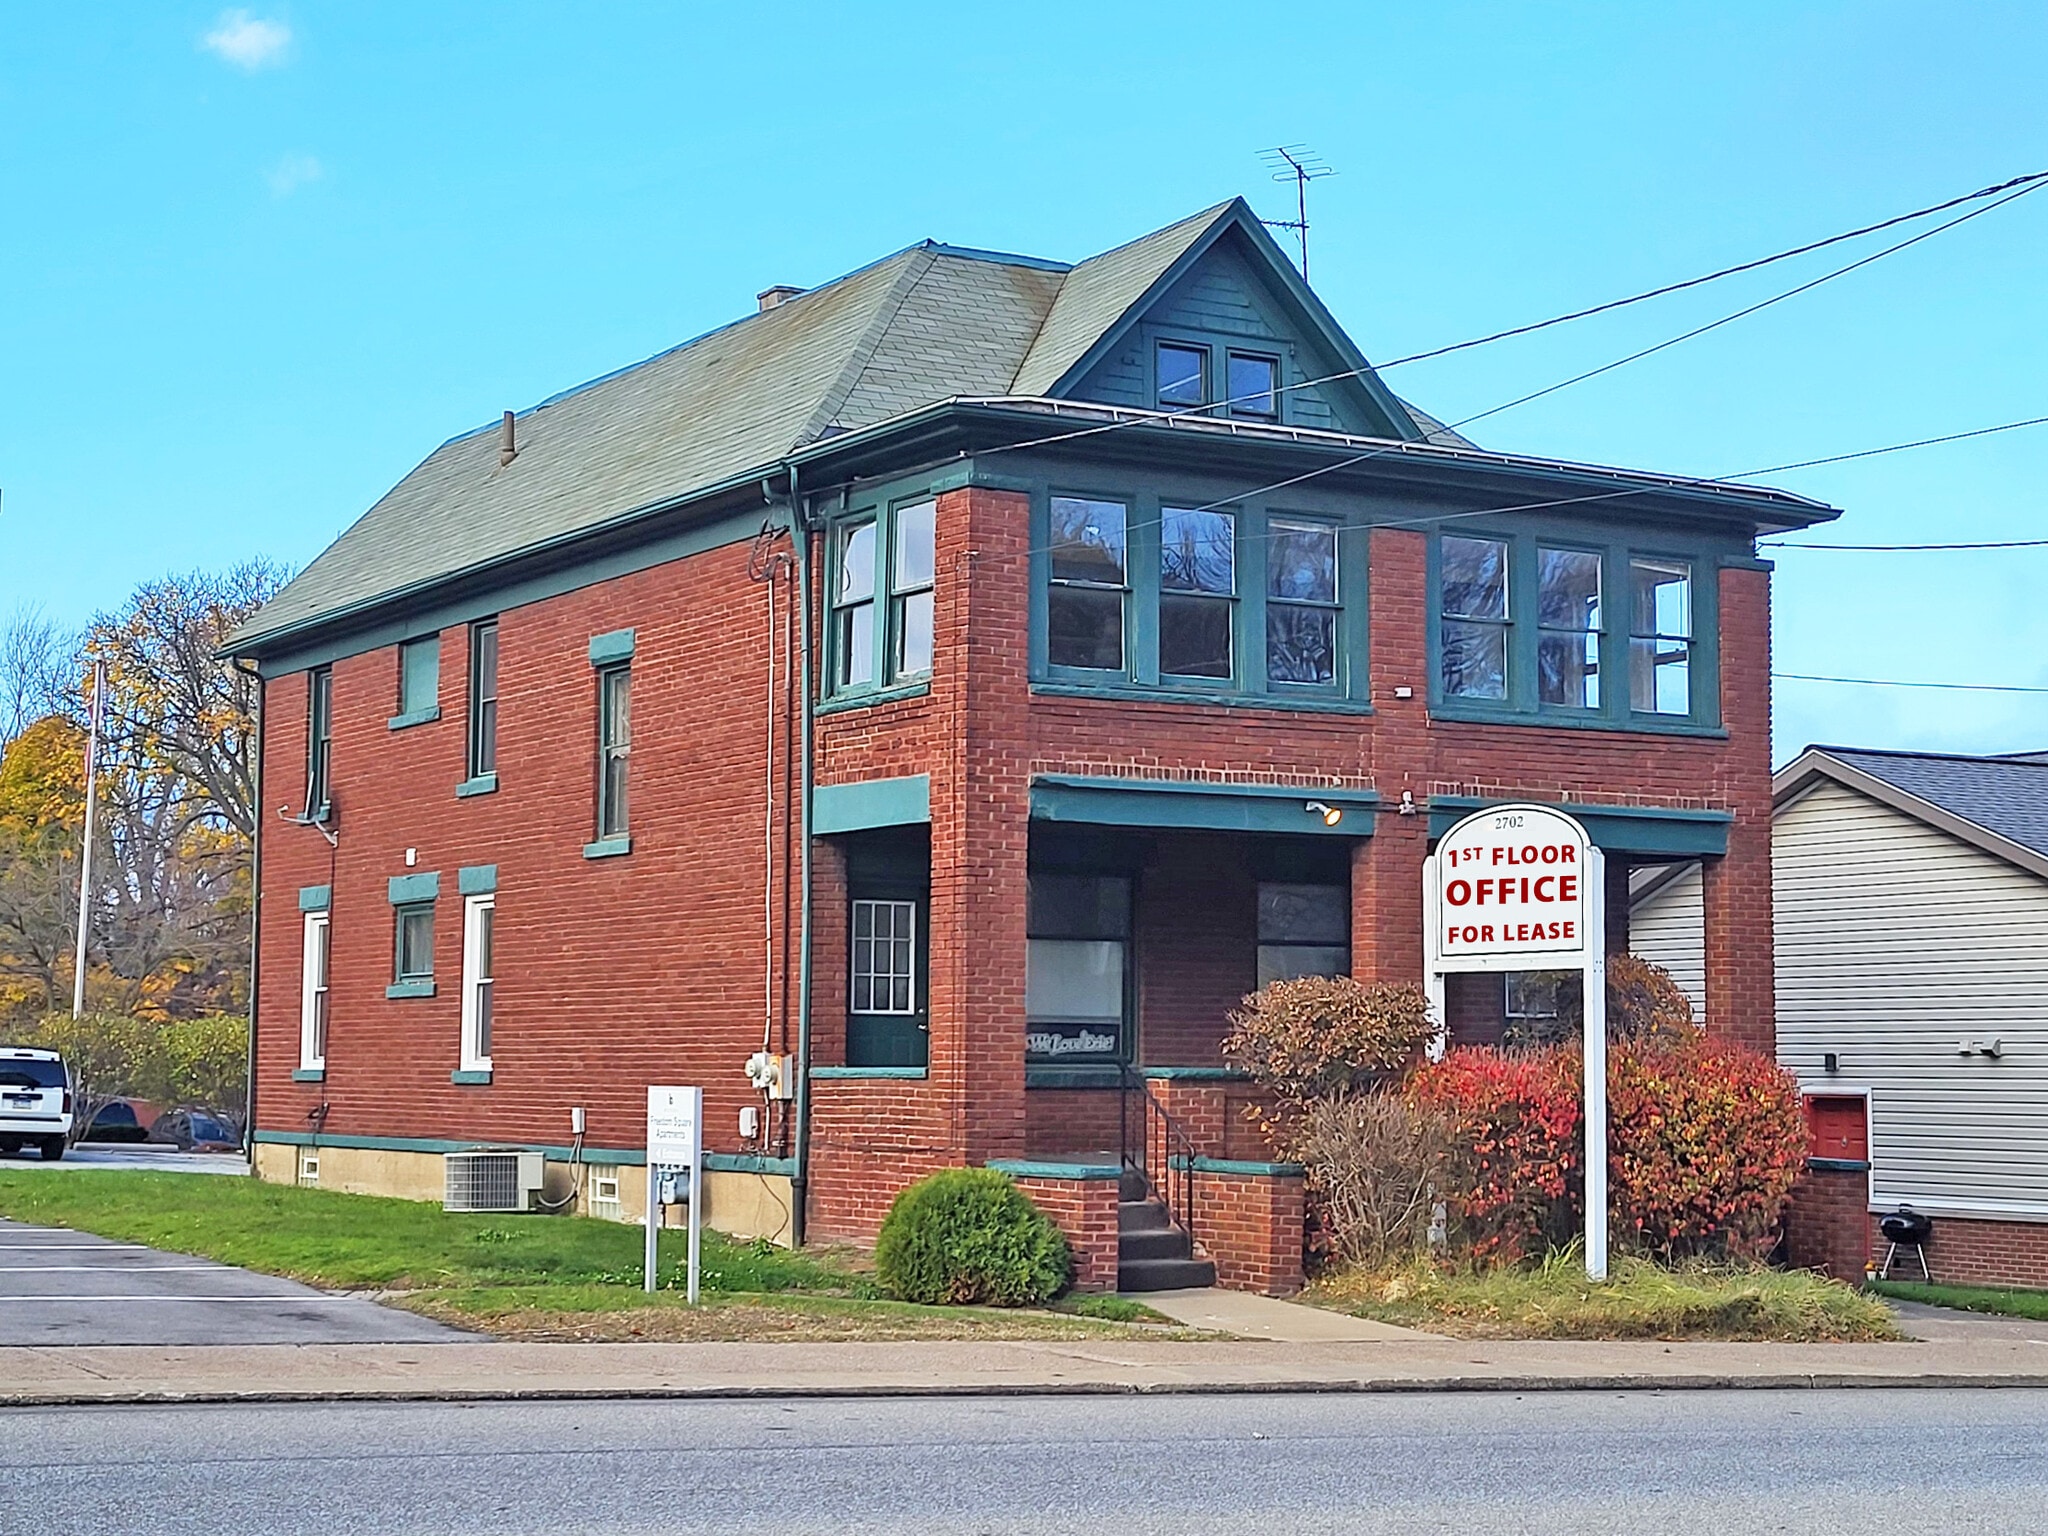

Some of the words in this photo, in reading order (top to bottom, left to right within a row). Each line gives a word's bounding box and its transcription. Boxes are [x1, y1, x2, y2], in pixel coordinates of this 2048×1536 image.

[1495, 816, 1524, 830] 2702
[1448, 847, 1483, 867] 1ST
[1492, 844, 1576, 866] FLOOR
[1446, 875, 1577, 906] OFFICE
[1448, 925, 1494, 944] FOR
[1503, 921, 1575, 942] LEASE
